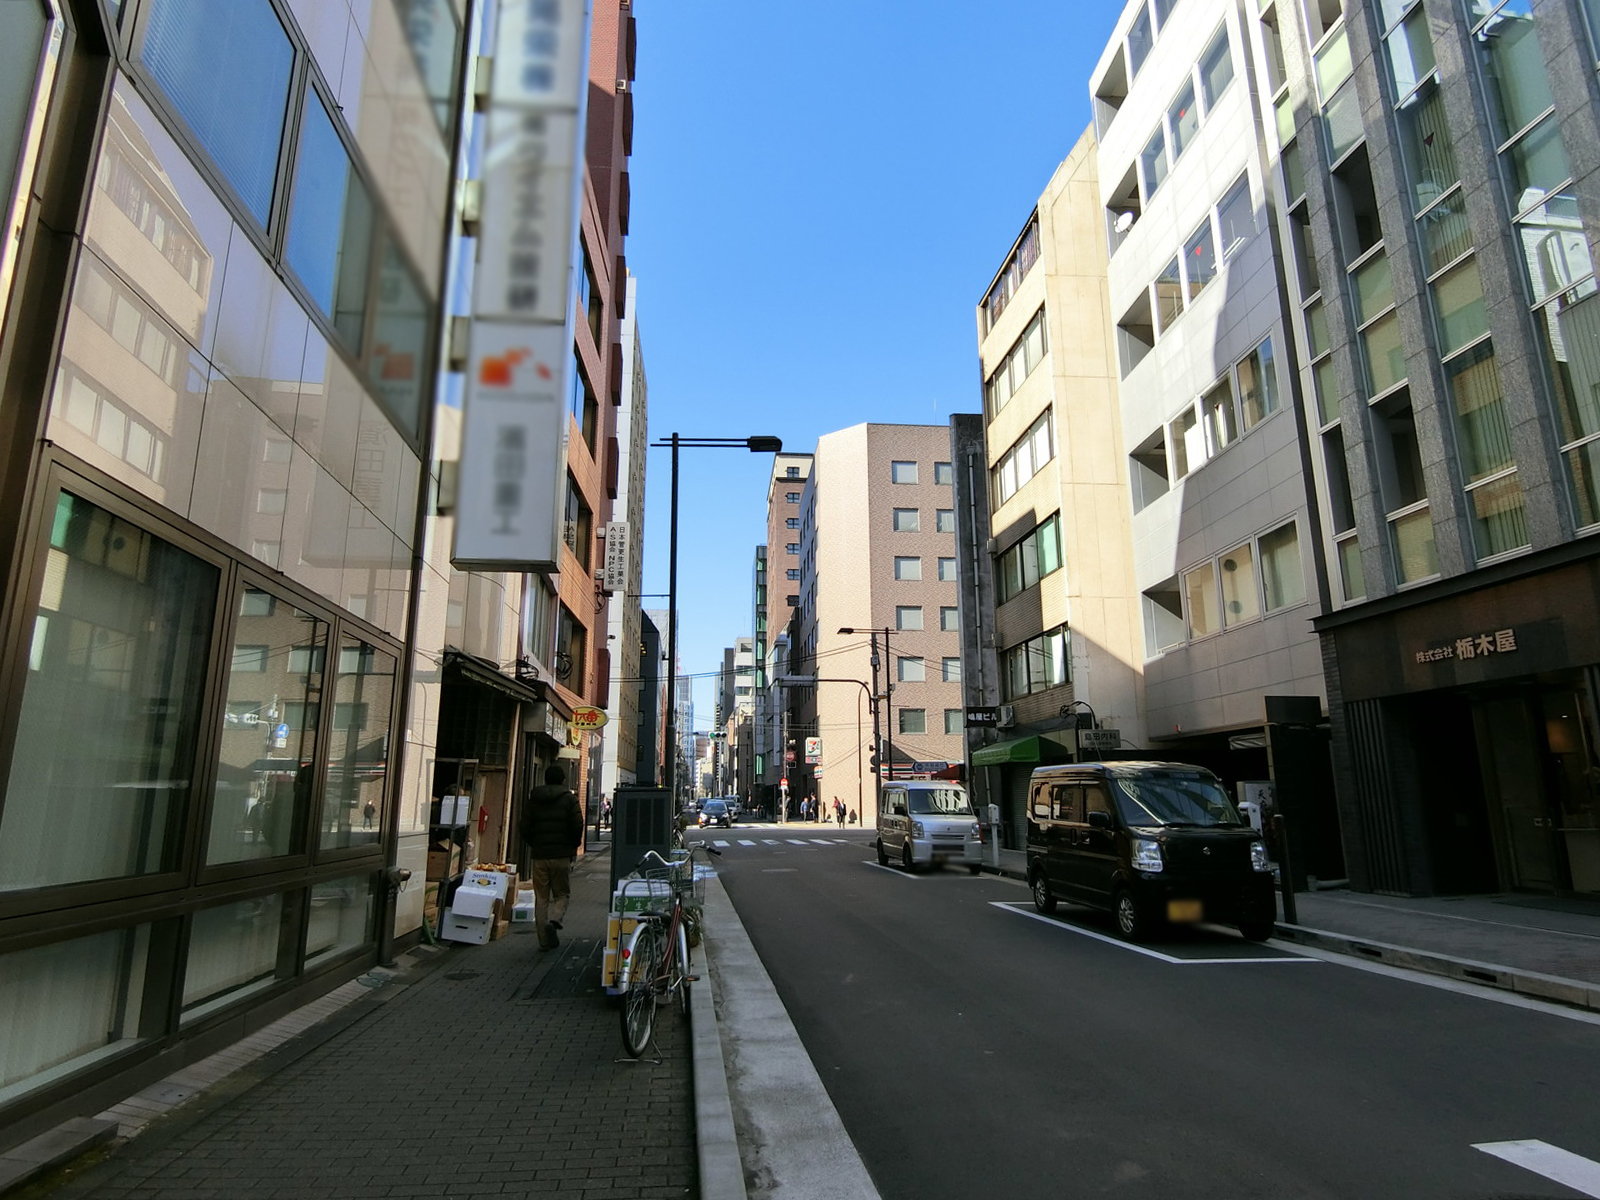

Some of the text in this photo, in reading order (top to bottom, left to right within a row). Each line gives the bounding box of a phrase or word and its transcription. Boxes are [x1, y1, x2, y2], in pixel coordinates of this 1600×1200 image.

[616, 526, 626, 585] 日本管更生工業会
[1415, 628, 1517, 664] 株式会社 栃木屋
